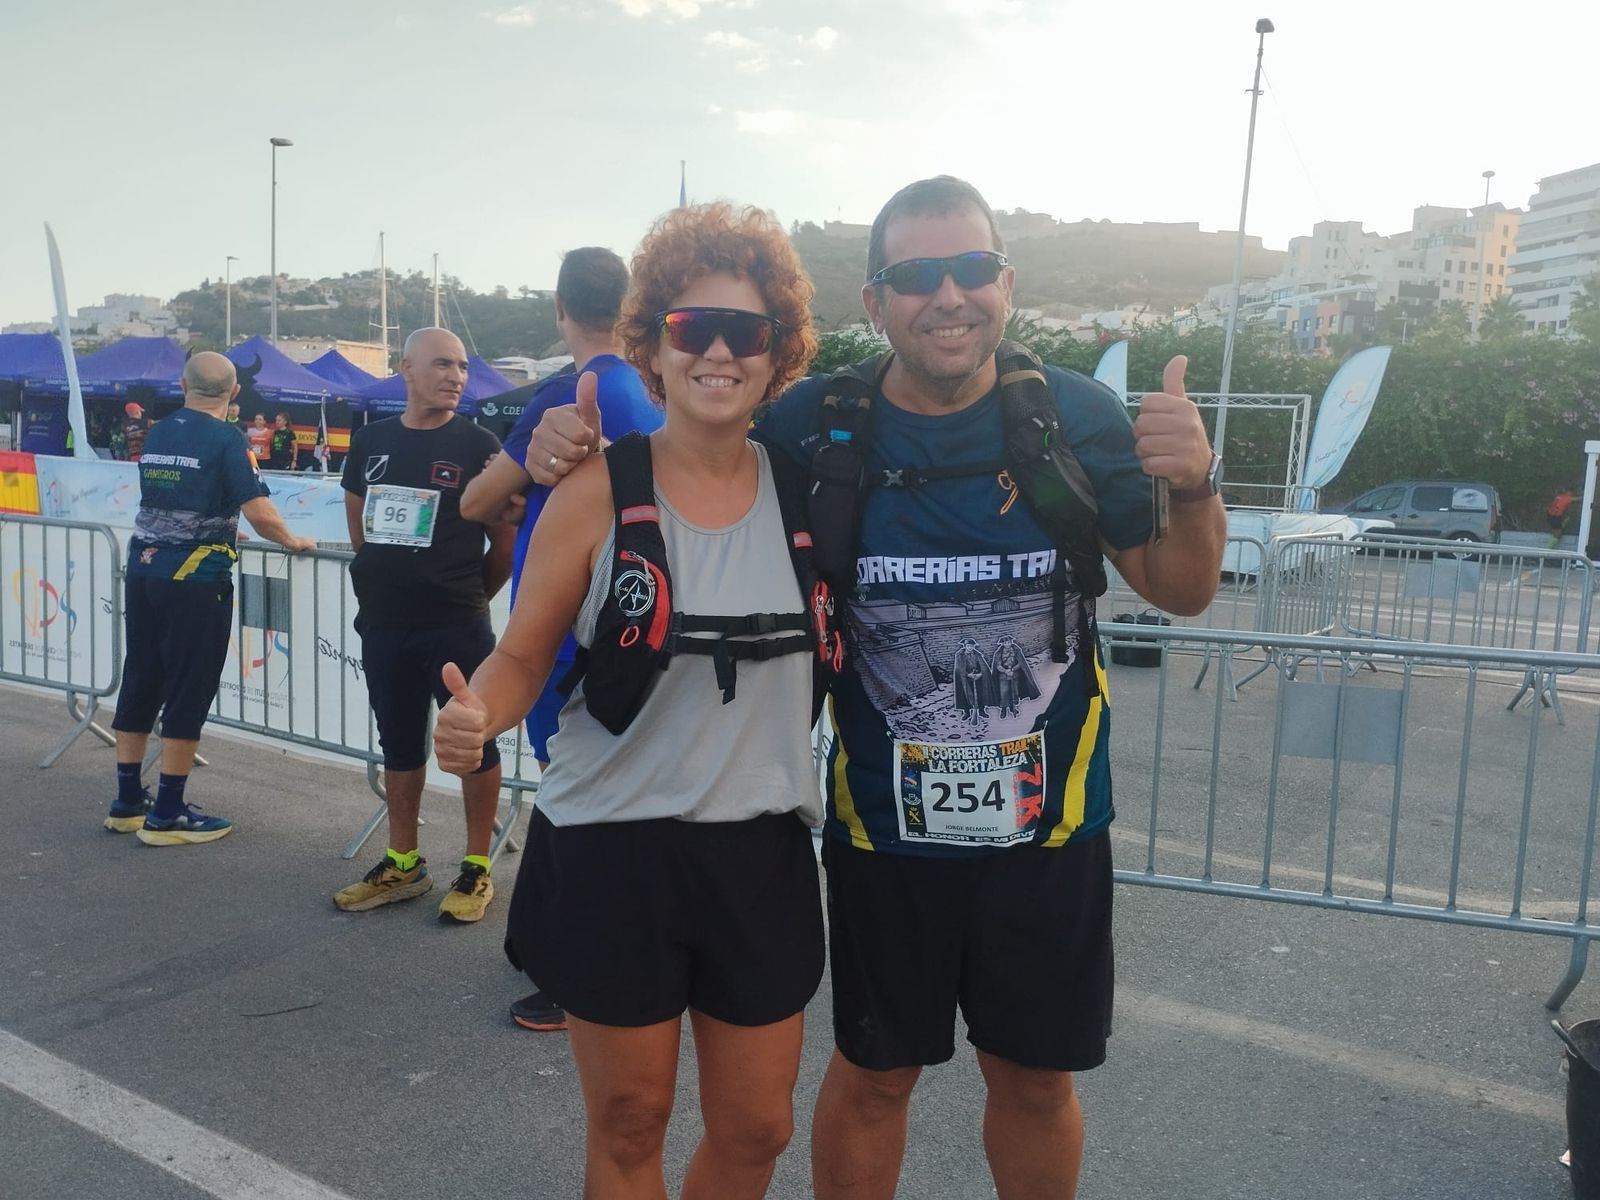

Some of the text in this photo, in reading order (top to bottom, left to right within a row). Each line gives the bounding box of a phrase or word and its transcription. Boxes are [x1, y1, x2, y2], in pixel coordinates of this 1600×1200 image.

[383, 506, 407, 523] 96
[857, 554, 1000, 584] ORRERÍAS
[931, 744, 997, 760] CORRERAS
[1000, 738, 1030, 756] TRAIL
[928, 752, 1028, 773] LA FORTALEZA
[930, 779, 1006, 813] 254
[925, 833, 969, 841] HONOR
